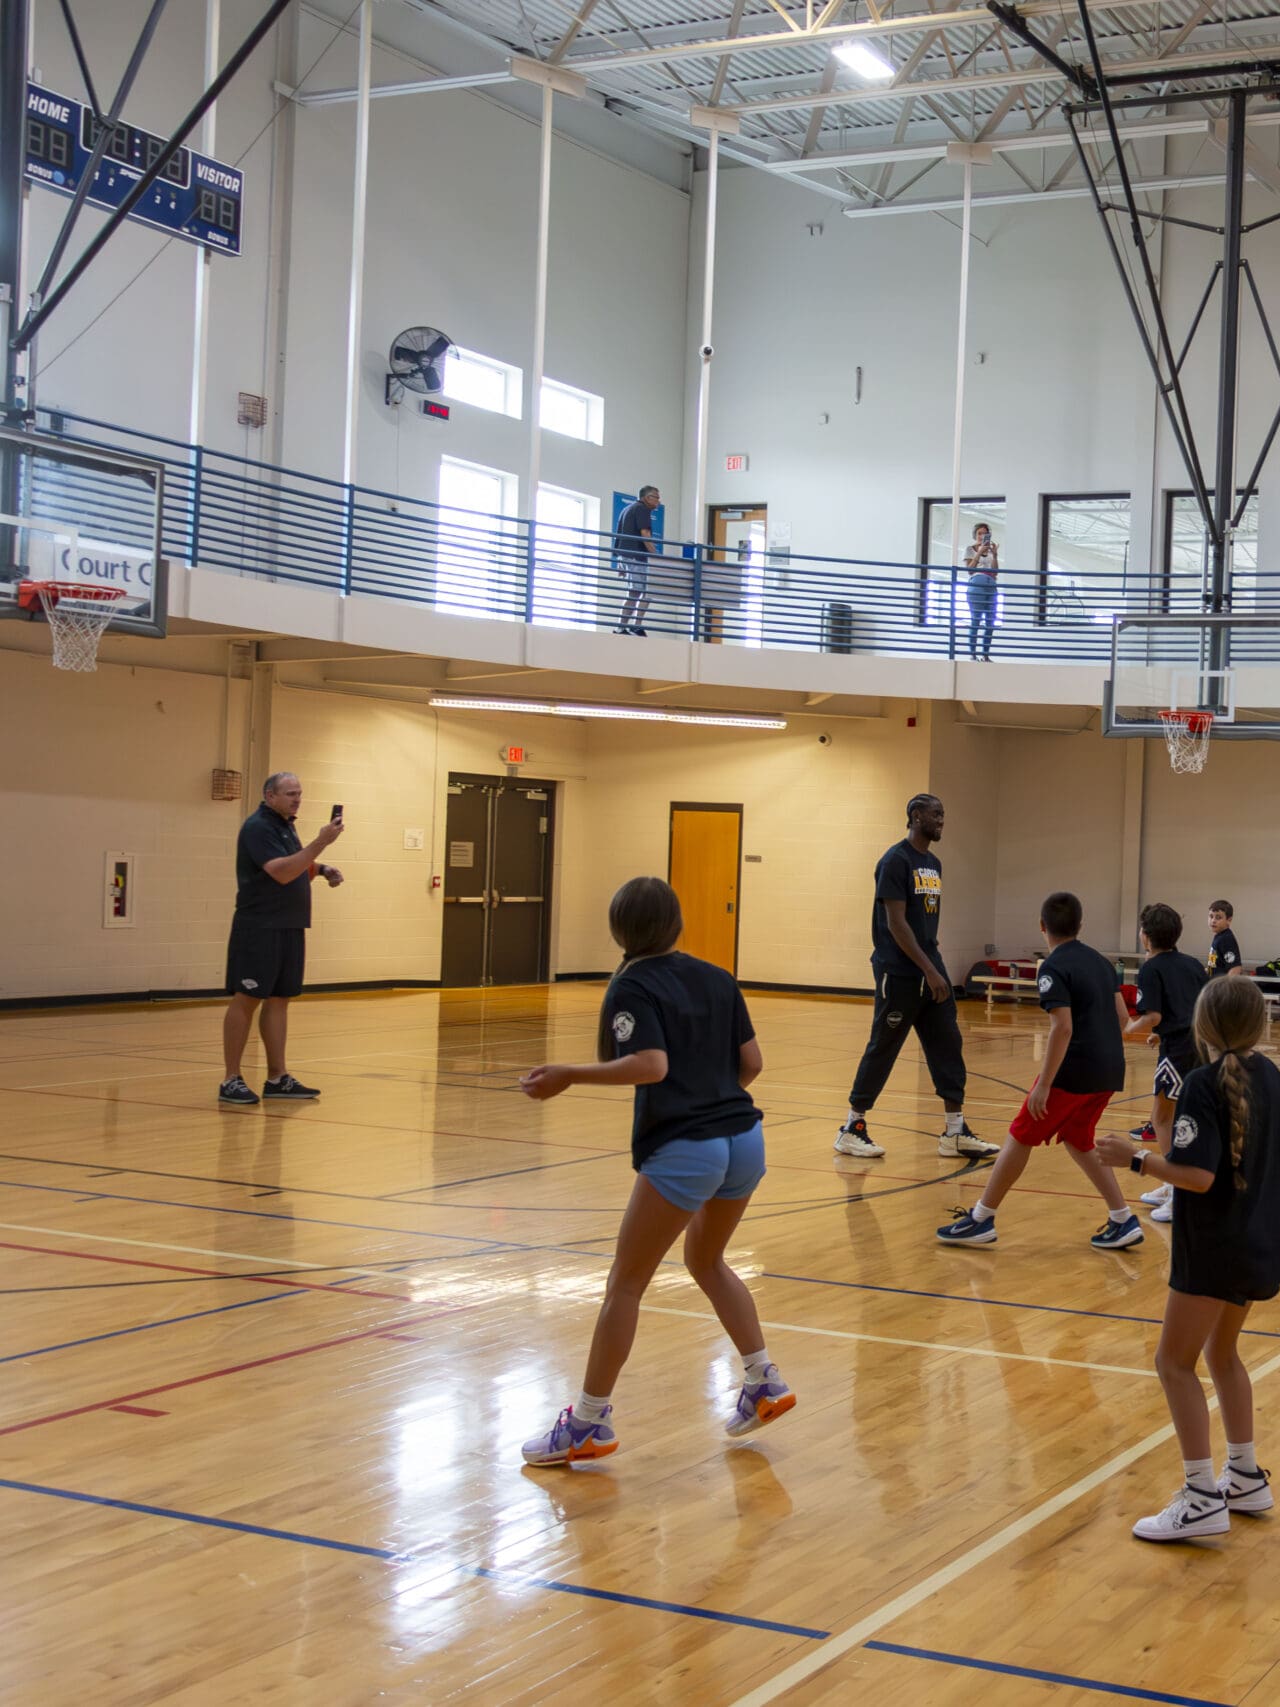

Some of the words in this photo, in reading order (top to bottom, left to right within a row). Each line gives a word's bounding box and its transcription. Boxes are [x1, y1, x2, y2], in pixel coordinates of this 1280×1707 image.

[28, 93, 71, 124] HOME
[108, 177, 115, 187] 2
[197, 162, 241, 193] VISITOR
